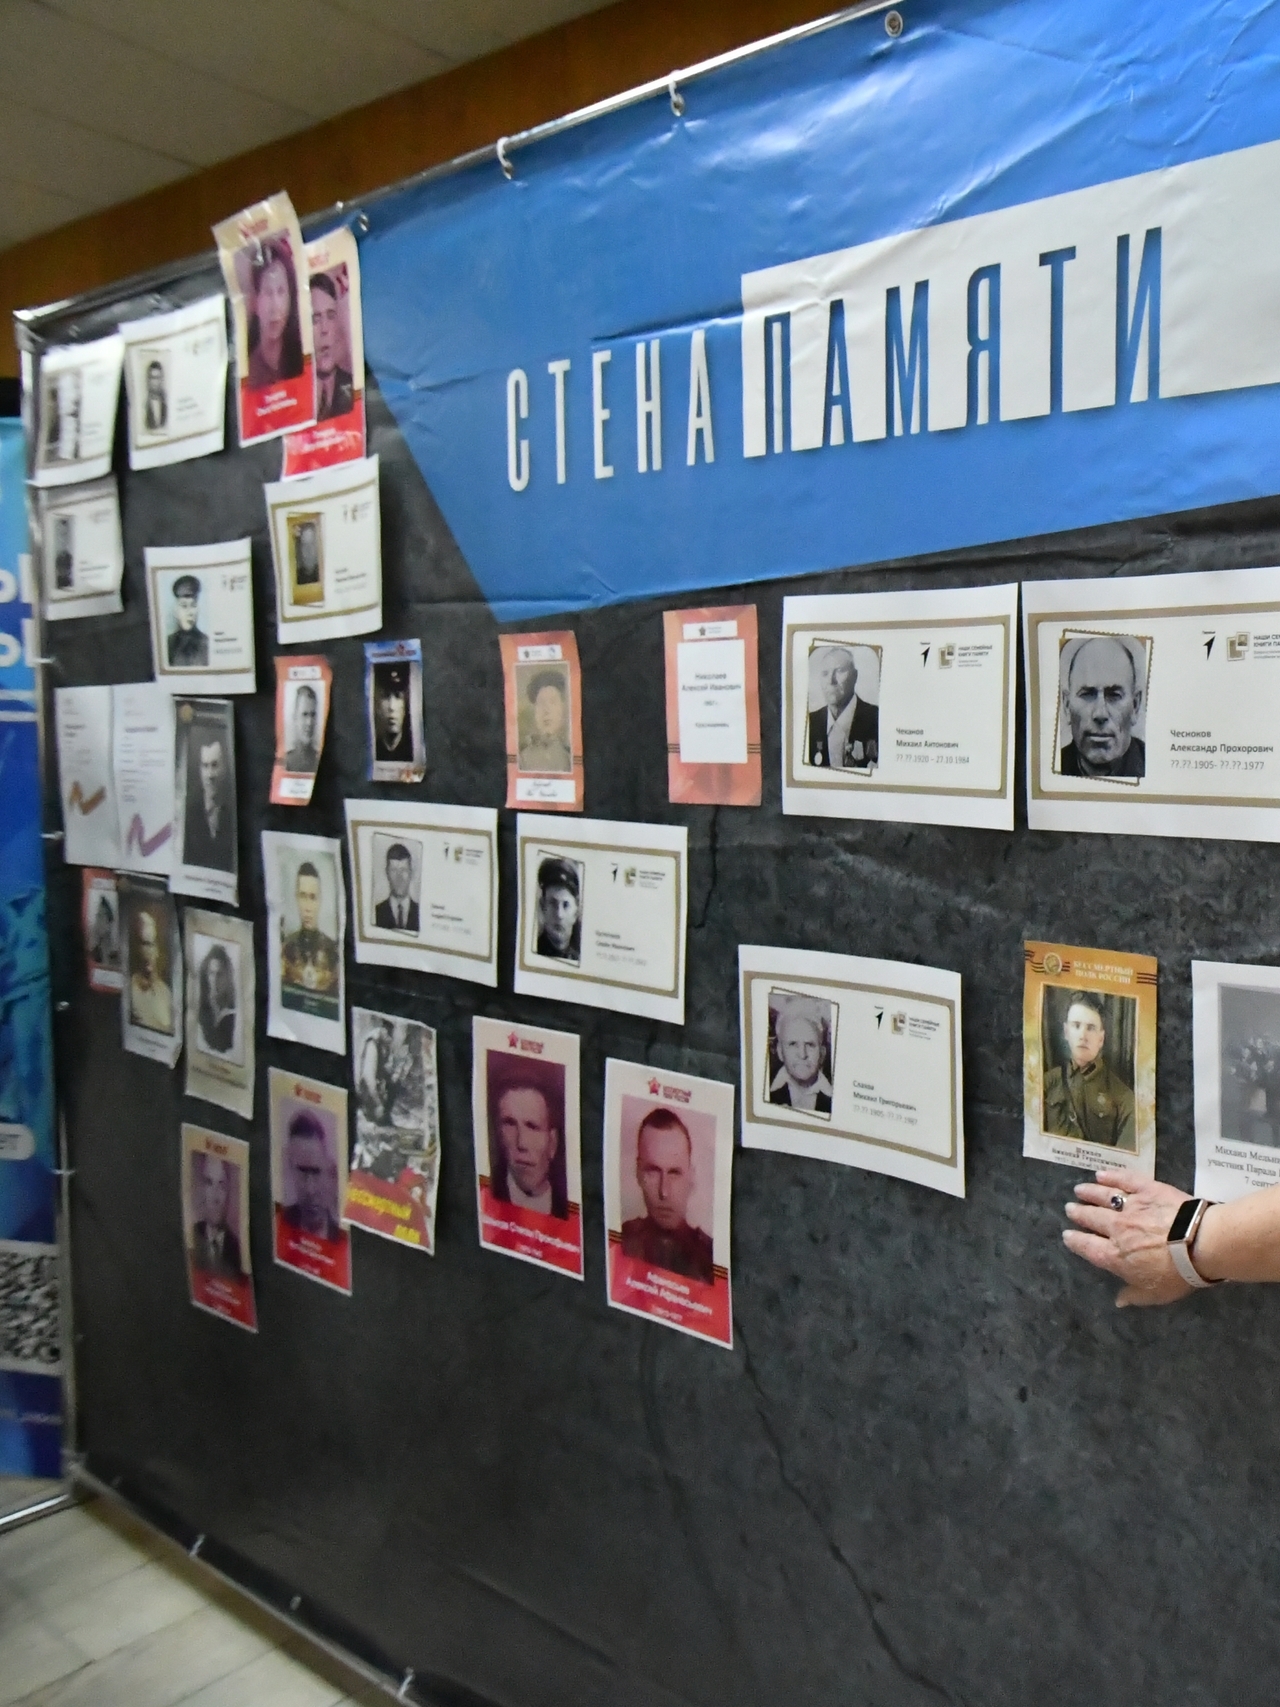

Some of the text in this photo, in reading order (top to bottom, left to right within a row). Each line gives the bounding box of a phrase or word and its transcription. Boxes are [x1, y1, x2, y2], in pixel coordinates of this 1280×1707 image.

[506, 226, 1163, 491] СТЕНА ПАМЯТИ
[1170, 730, 1212, 738] Чесноков
[896, 740, 922, 748] Михаил
[1170, 743, 1274, 754] Александр Прохорович
[1215, 1145, 1247, 1158] Михаил
[1207, 1158, 1245, 1170] участник
[1246, 1164, 1277, 1177] Парада
